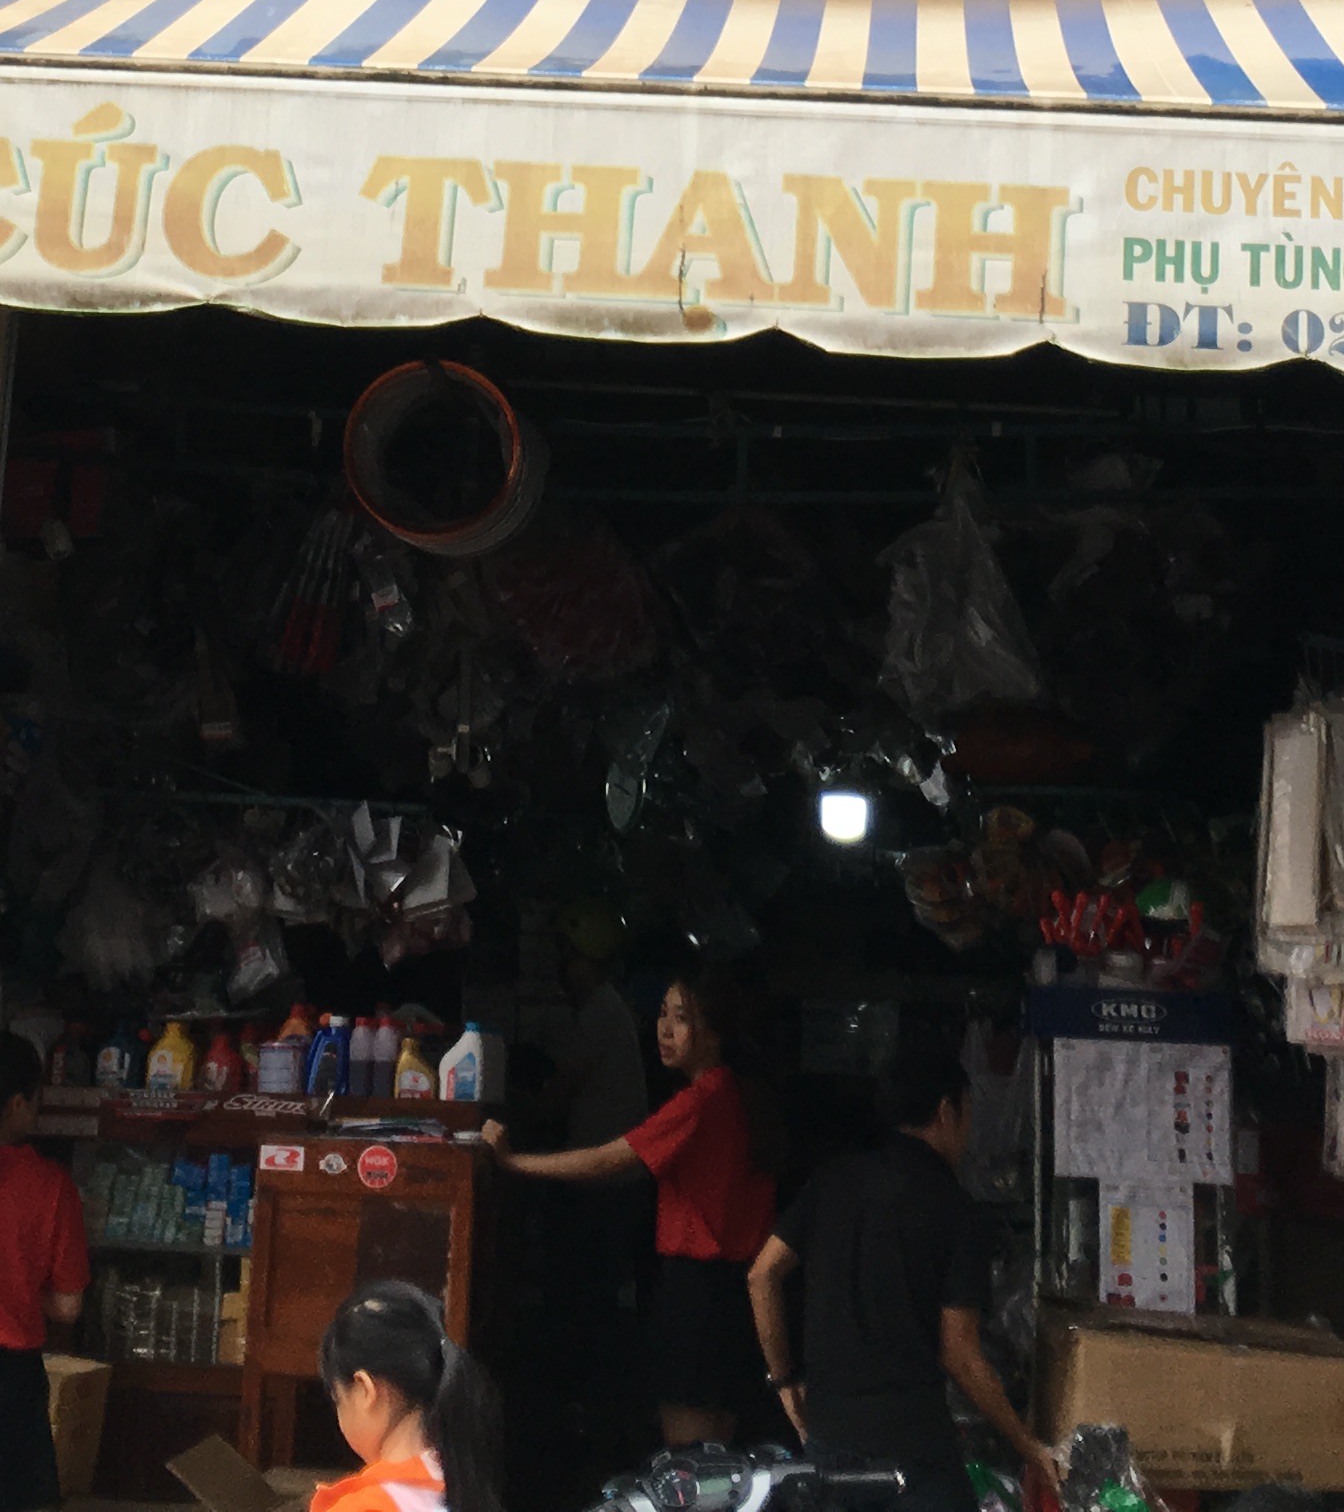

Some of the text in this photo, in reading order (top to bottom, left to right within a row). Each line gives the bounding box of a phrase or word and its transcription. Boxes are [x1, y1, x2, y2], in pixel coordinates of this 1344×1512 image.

[1123, 161, 1344, 222] CHUYÊN
[361, 148, 1083, 336] THẠNH
[1120, 236, 1221, 300] PHỤ
[1122, 299, 1254, 356] ĐT:
